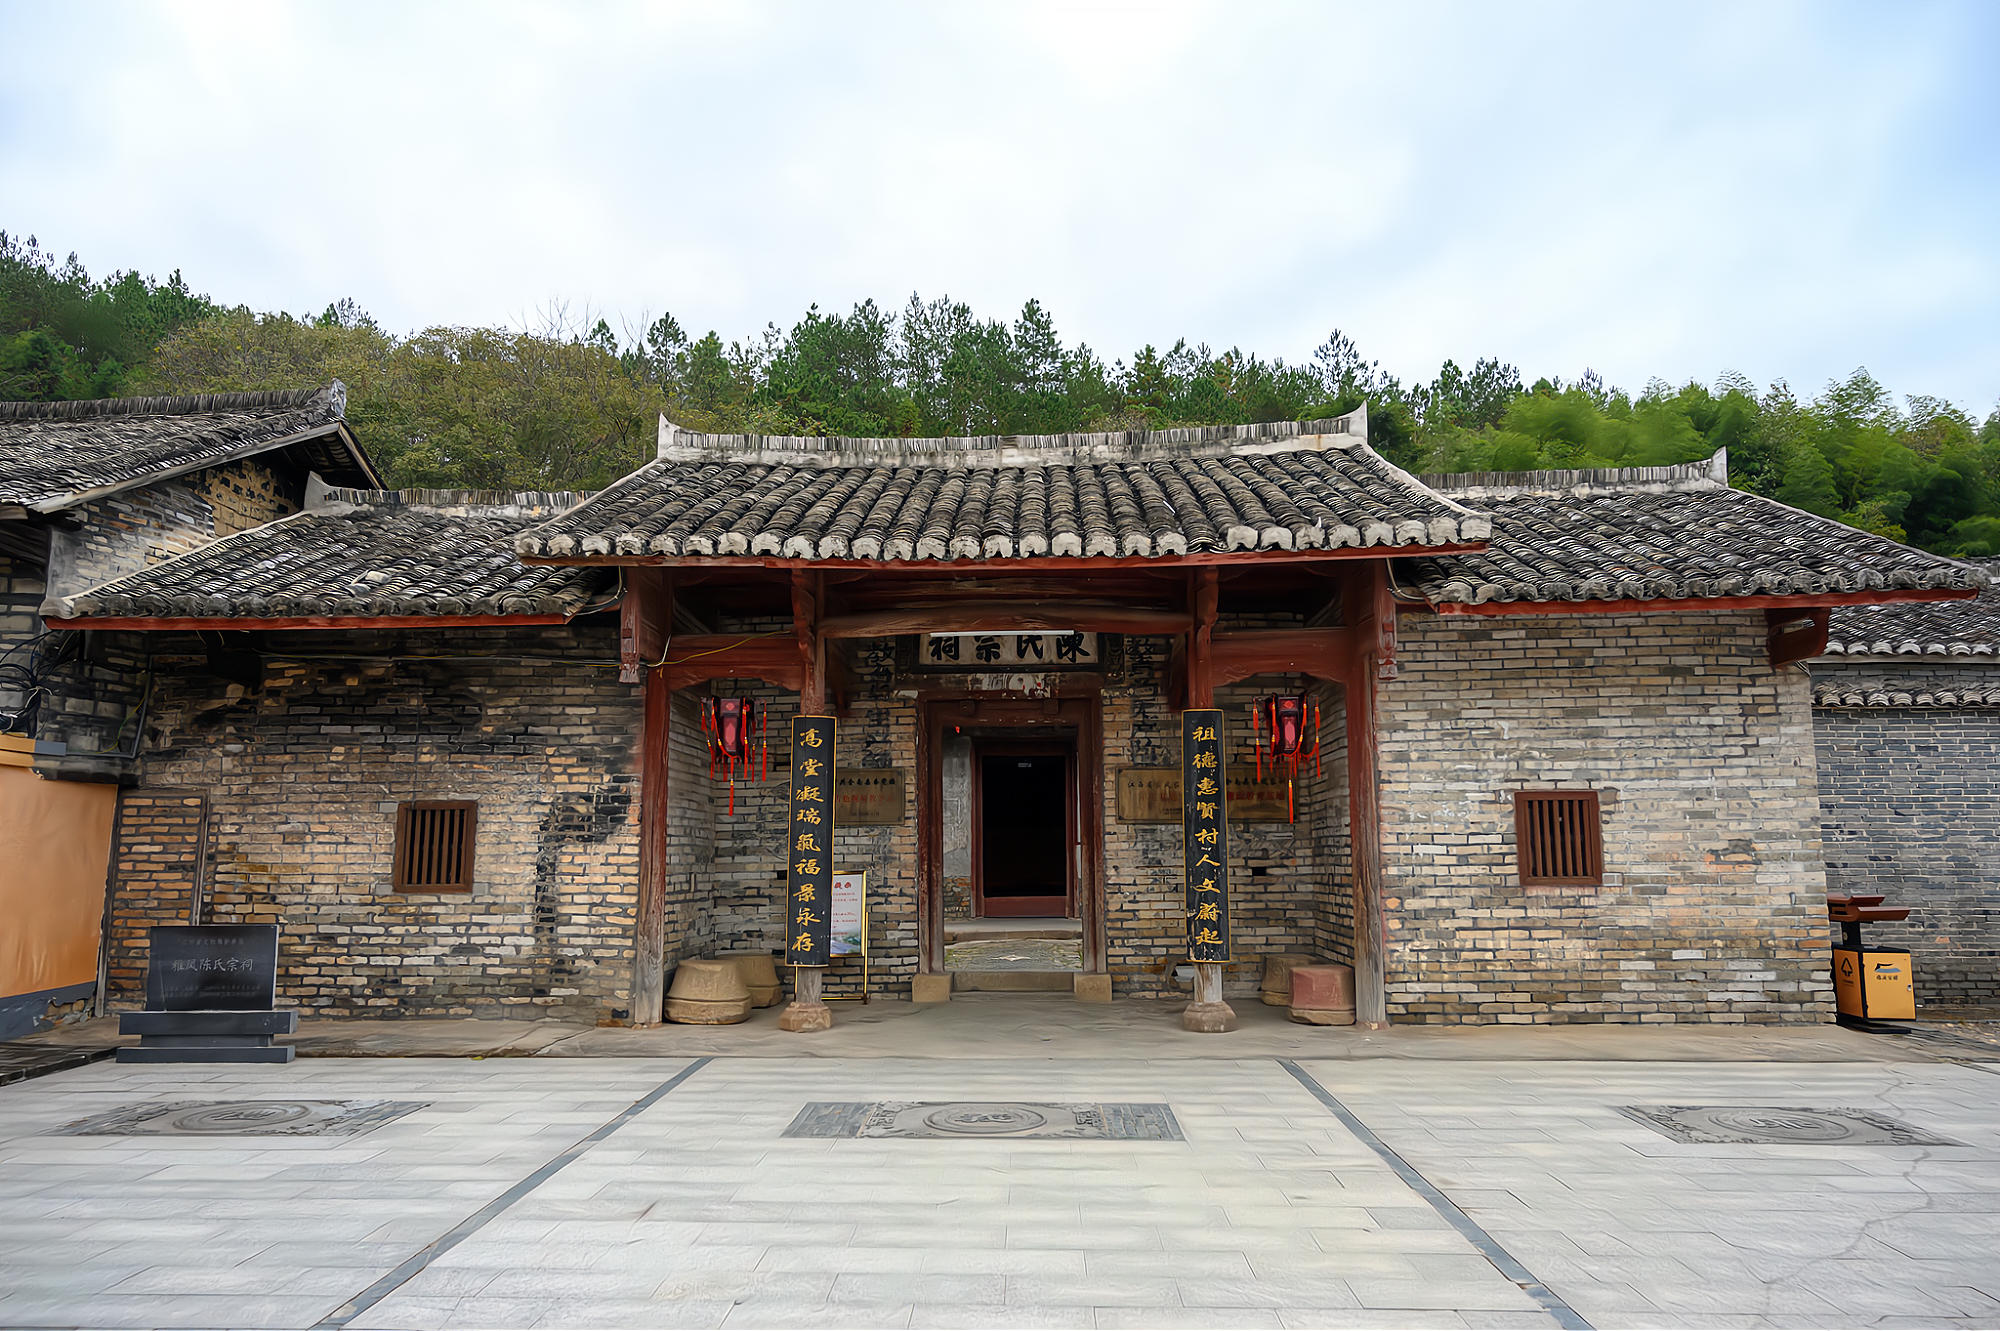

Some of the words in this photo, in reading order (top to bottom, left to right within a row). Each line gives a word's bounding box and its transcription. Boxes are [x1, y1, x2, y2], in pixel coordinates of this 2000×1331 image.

[171, 957, 254, 972] 雅凤陈氏宗祠
